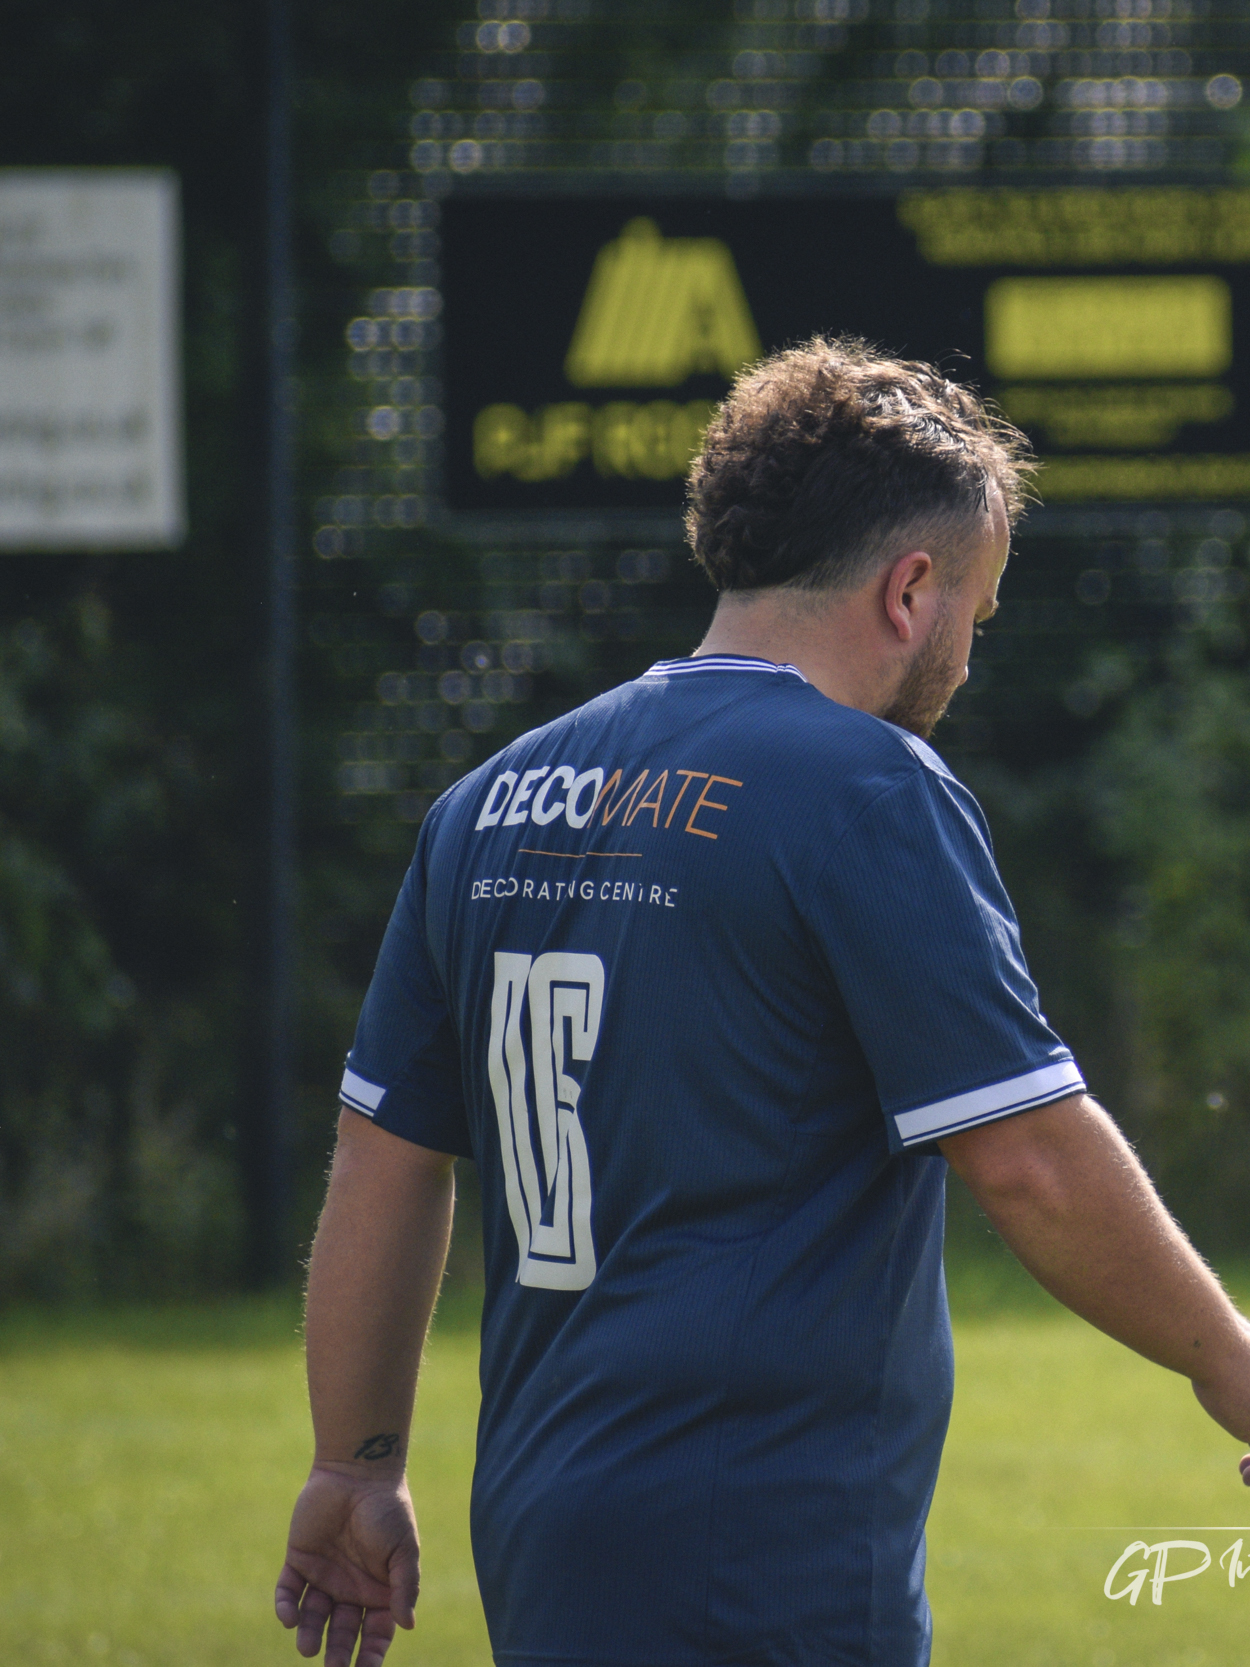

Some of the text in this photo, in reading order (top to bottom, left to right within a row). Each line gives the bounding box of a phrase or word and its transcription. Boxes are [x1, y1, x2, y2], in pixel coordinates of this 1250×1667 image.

[474, 765, 744, 840] DECOMATE
[471, 877, 595, 901] DECORATNG
[488, 951, 606, 1292] 16
